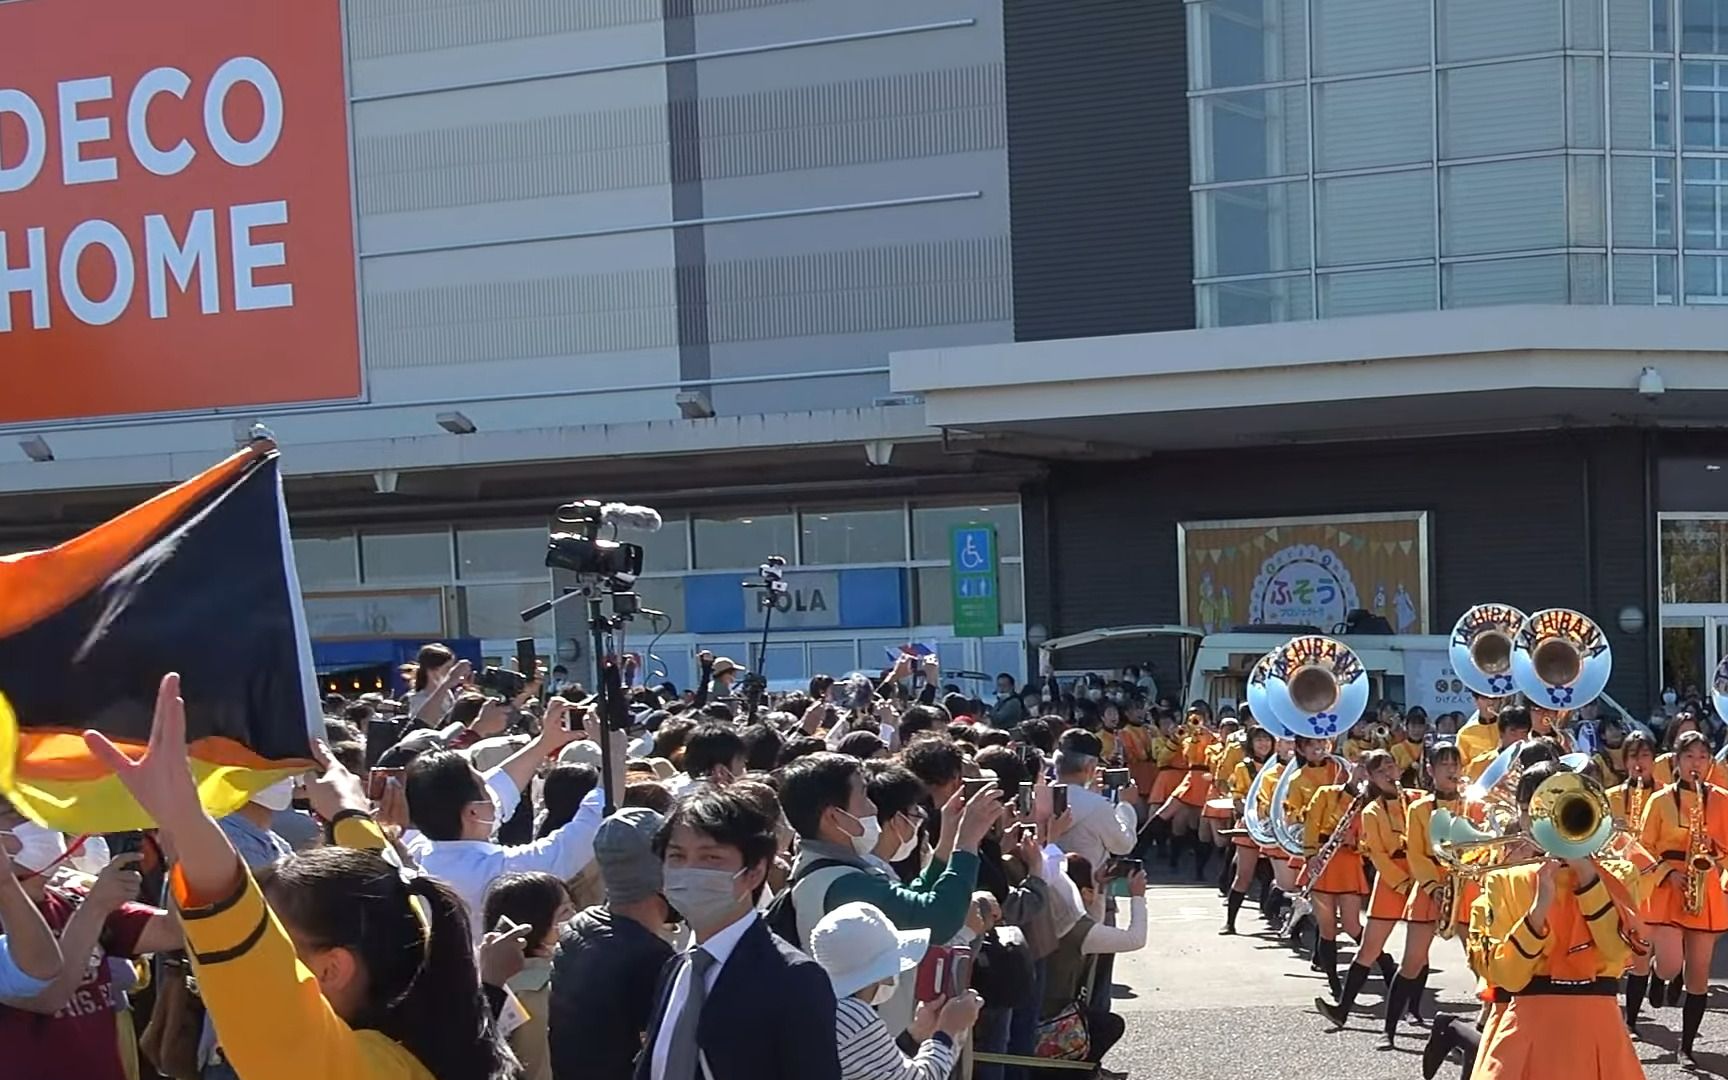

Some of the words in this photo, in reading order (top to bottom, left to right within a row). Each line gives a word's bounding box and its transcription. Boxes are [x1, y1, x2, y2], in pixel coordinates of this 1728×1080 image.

[0, 56, 284, 193] DECO
[0, 200, 294, 332] HOME
[756, 588, 828, 614] POLA
[1270, 577, 1336, 606] ふそう
[1452, 606, 1523, 648] TACHIBA
[1514, 610, 1608, 659] TACHIBANA
